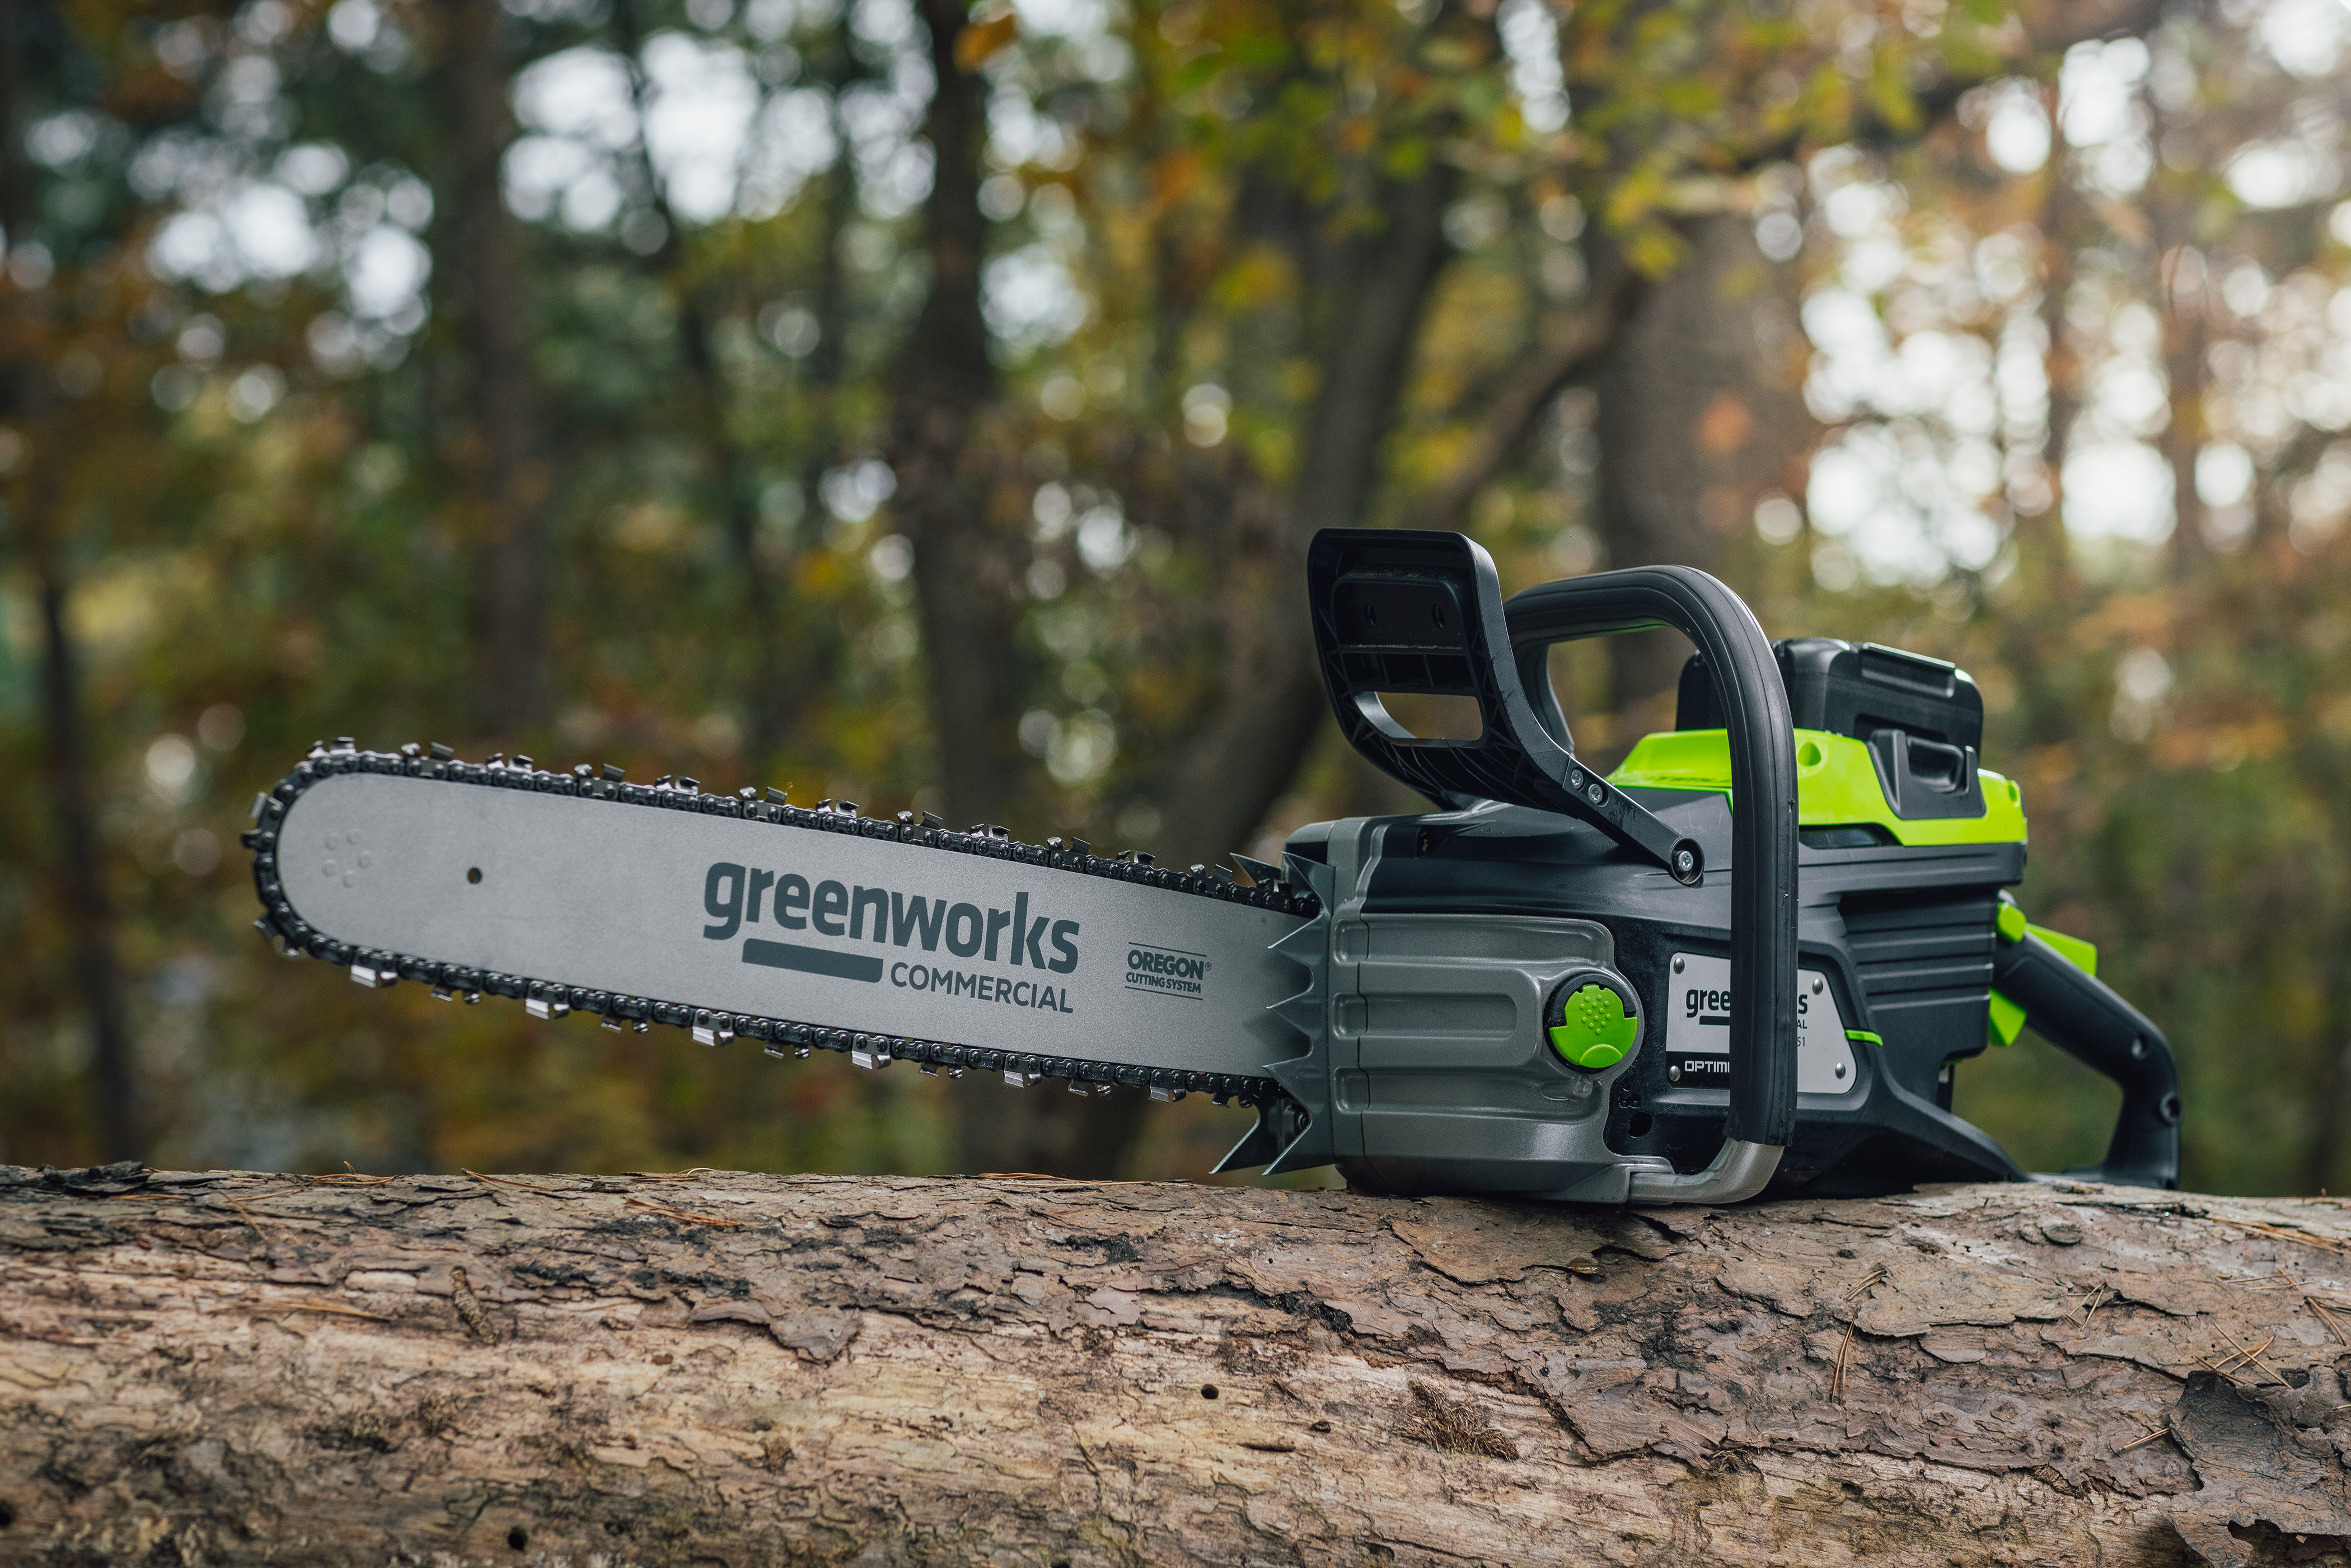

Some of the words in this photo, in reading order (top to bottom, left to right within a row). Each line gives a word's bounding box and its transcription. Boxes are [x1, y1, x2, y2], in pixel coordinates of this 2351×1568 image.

[704, 862, 1080, 974] greenworks
[890, 961, 1074, 1014] COMMERCIAL
[1126, 972, 1165, 988] CUTTING
[1166, 979, 1201, 994] SYSTEM
